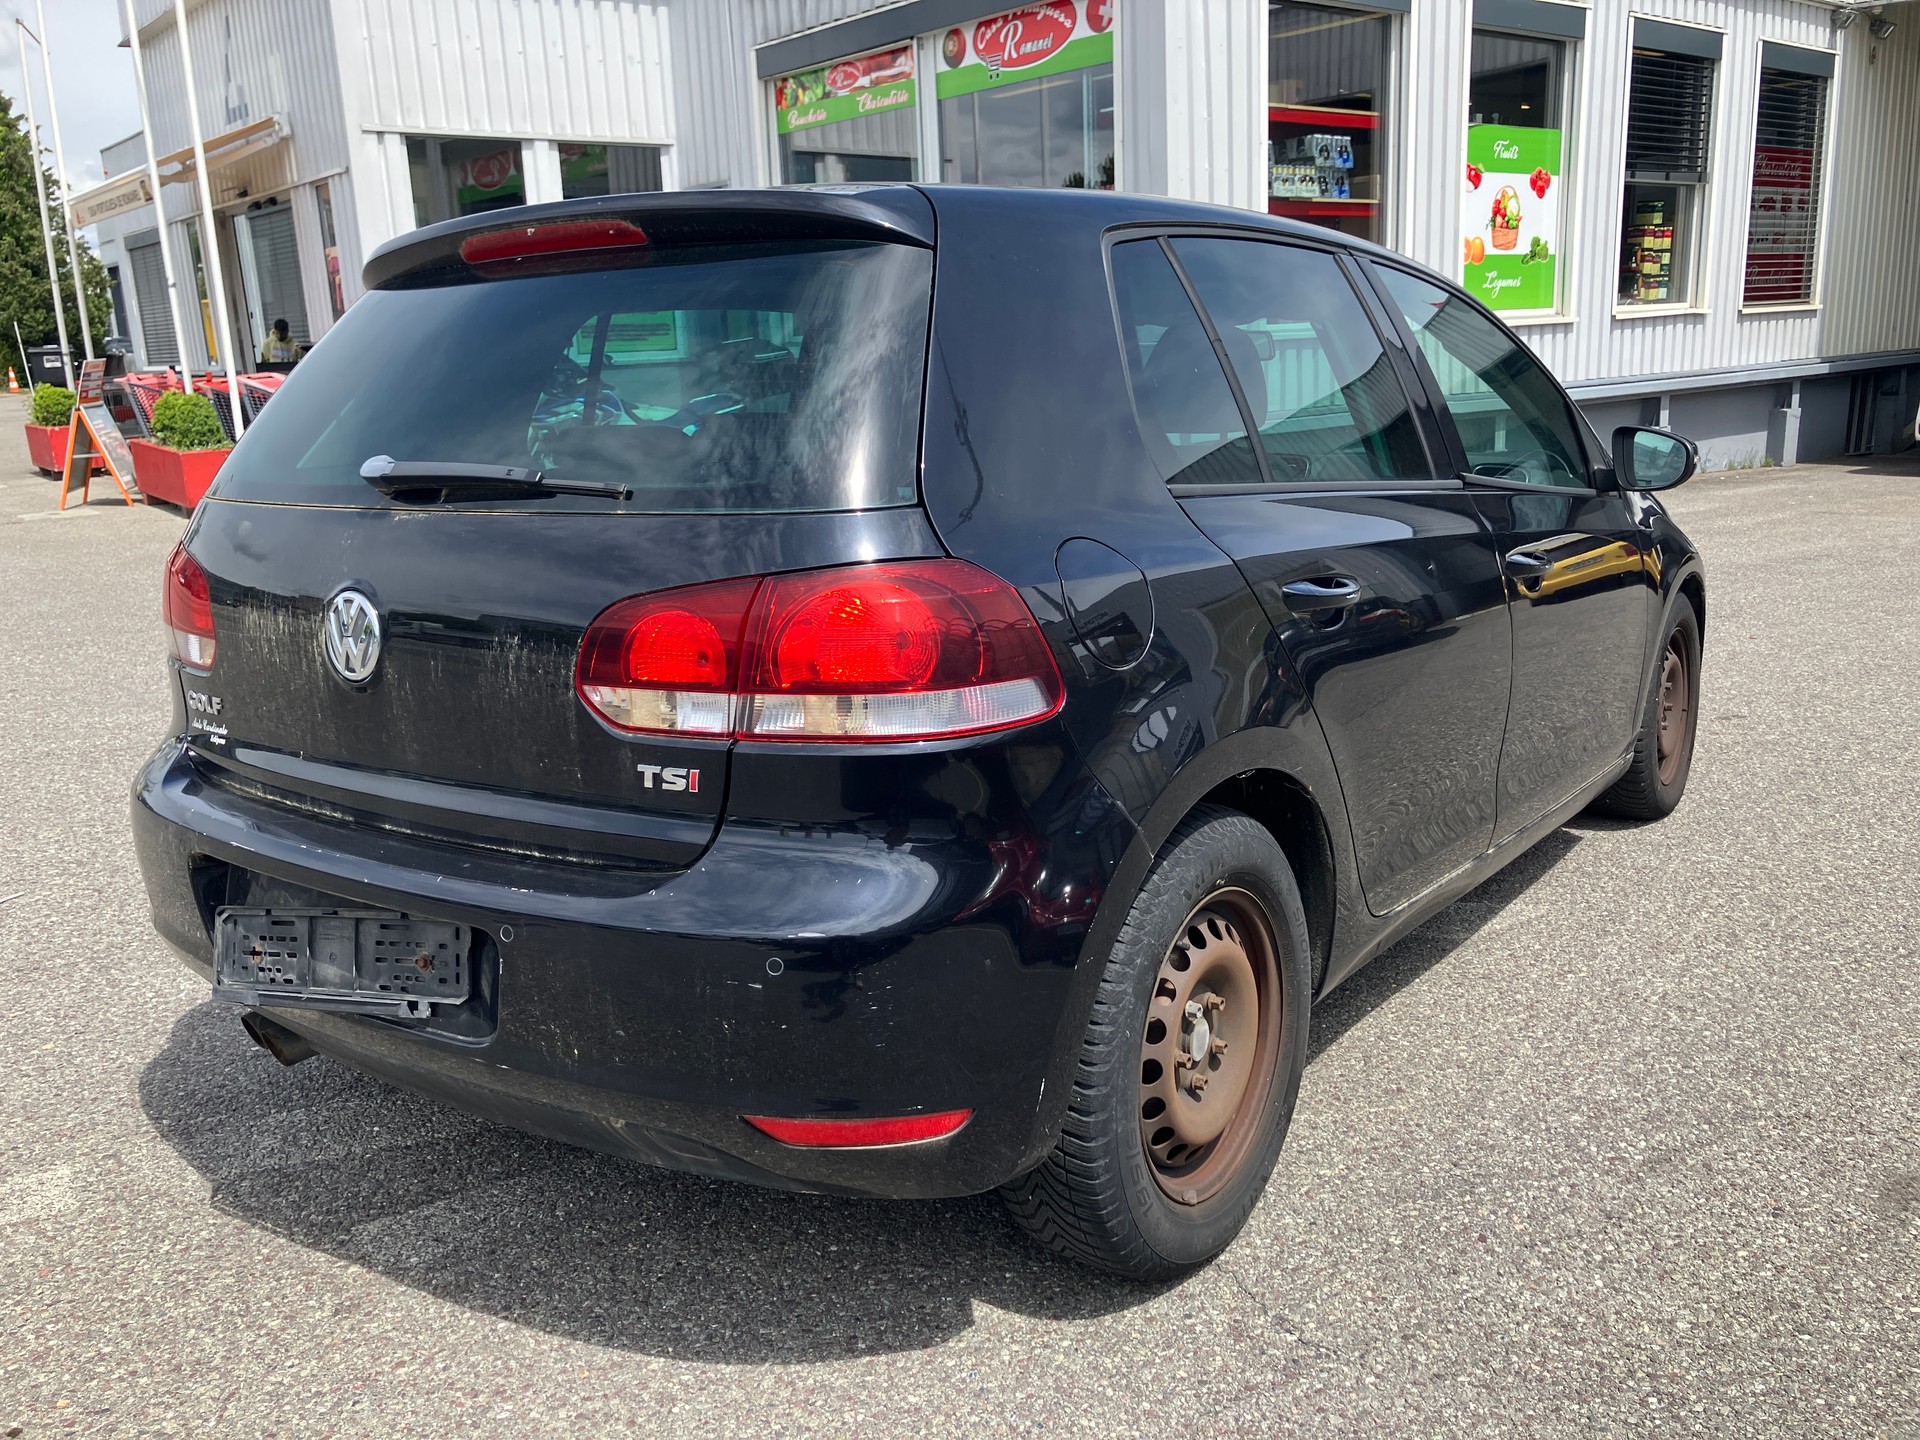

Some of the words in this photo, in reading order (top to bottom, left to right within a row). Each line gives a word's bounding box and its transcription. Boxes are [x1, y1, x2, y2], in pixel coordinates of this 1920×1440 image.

[1000, 20, 1054, 61] Romanel
[1493, 139, 1519, 160] Fruits
[187, 689, 223, 715] GOLF
[637, 764, 700, 793] TSI
